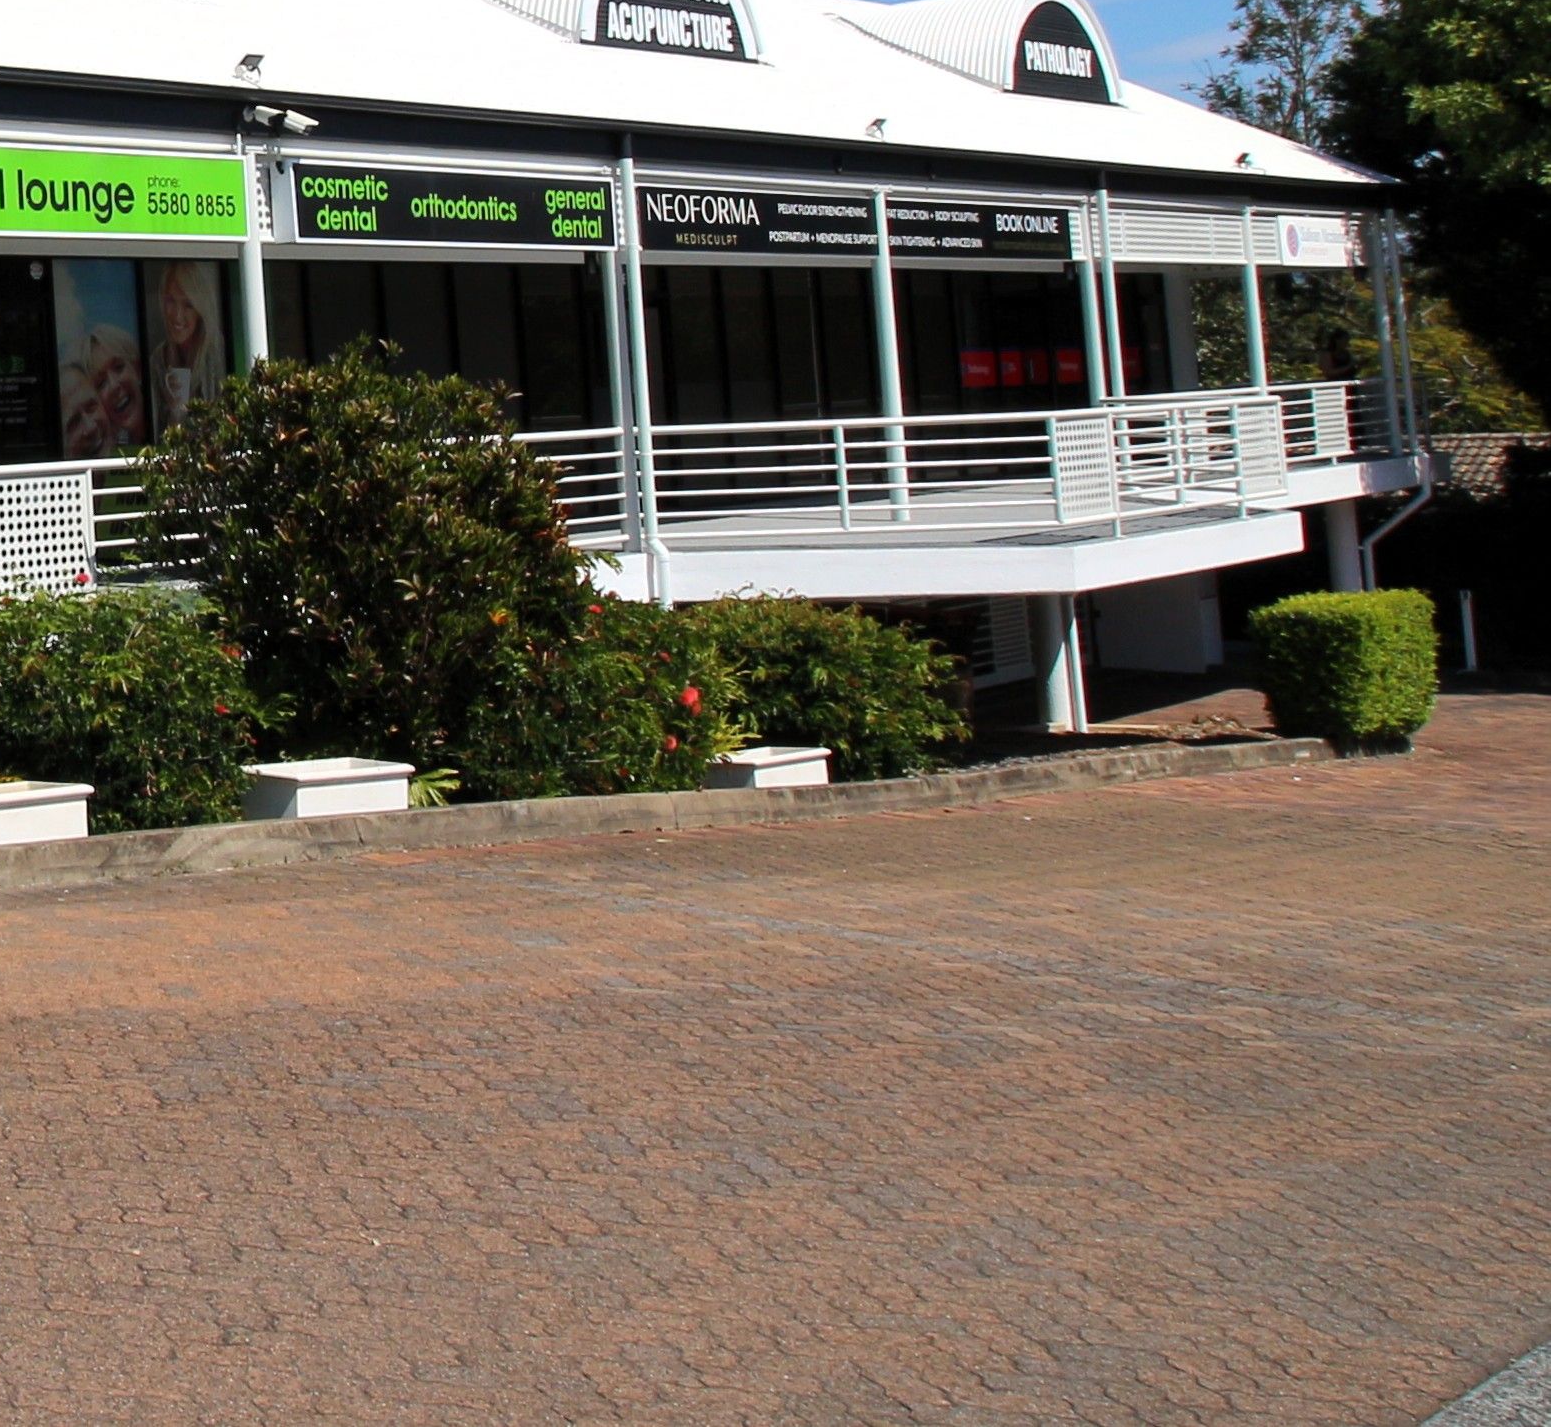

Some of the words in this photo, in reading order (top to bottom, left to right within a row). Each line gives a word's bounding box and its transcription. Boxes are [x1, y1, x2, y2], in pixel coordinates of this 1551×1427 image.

[607, 1, 735, 53] ACUPUNCTURE
[1023, 39, 1093, 79] PATHOLOGY
[17, 169, 135, 224] lounge
[146, 175, 181, 191] phone:
[301, 174, 390, 201] cosmetic
[147, 192, 190, 216] 5580
[195, 194, 237, 218] 8855
[410, 193, 518, 222] orthodontics
[544, 187, 606, 215] general
[646, 193, 761, 226] NEOFORMA
[316, 204, 378, 232] dental
[551, 214, 603, 239] dental
[995, 213, 1025, 233] BOOK
[1024, 215, 1059, 234] ONLINE
[675, 233, 738, 246] MEDISCULPT
